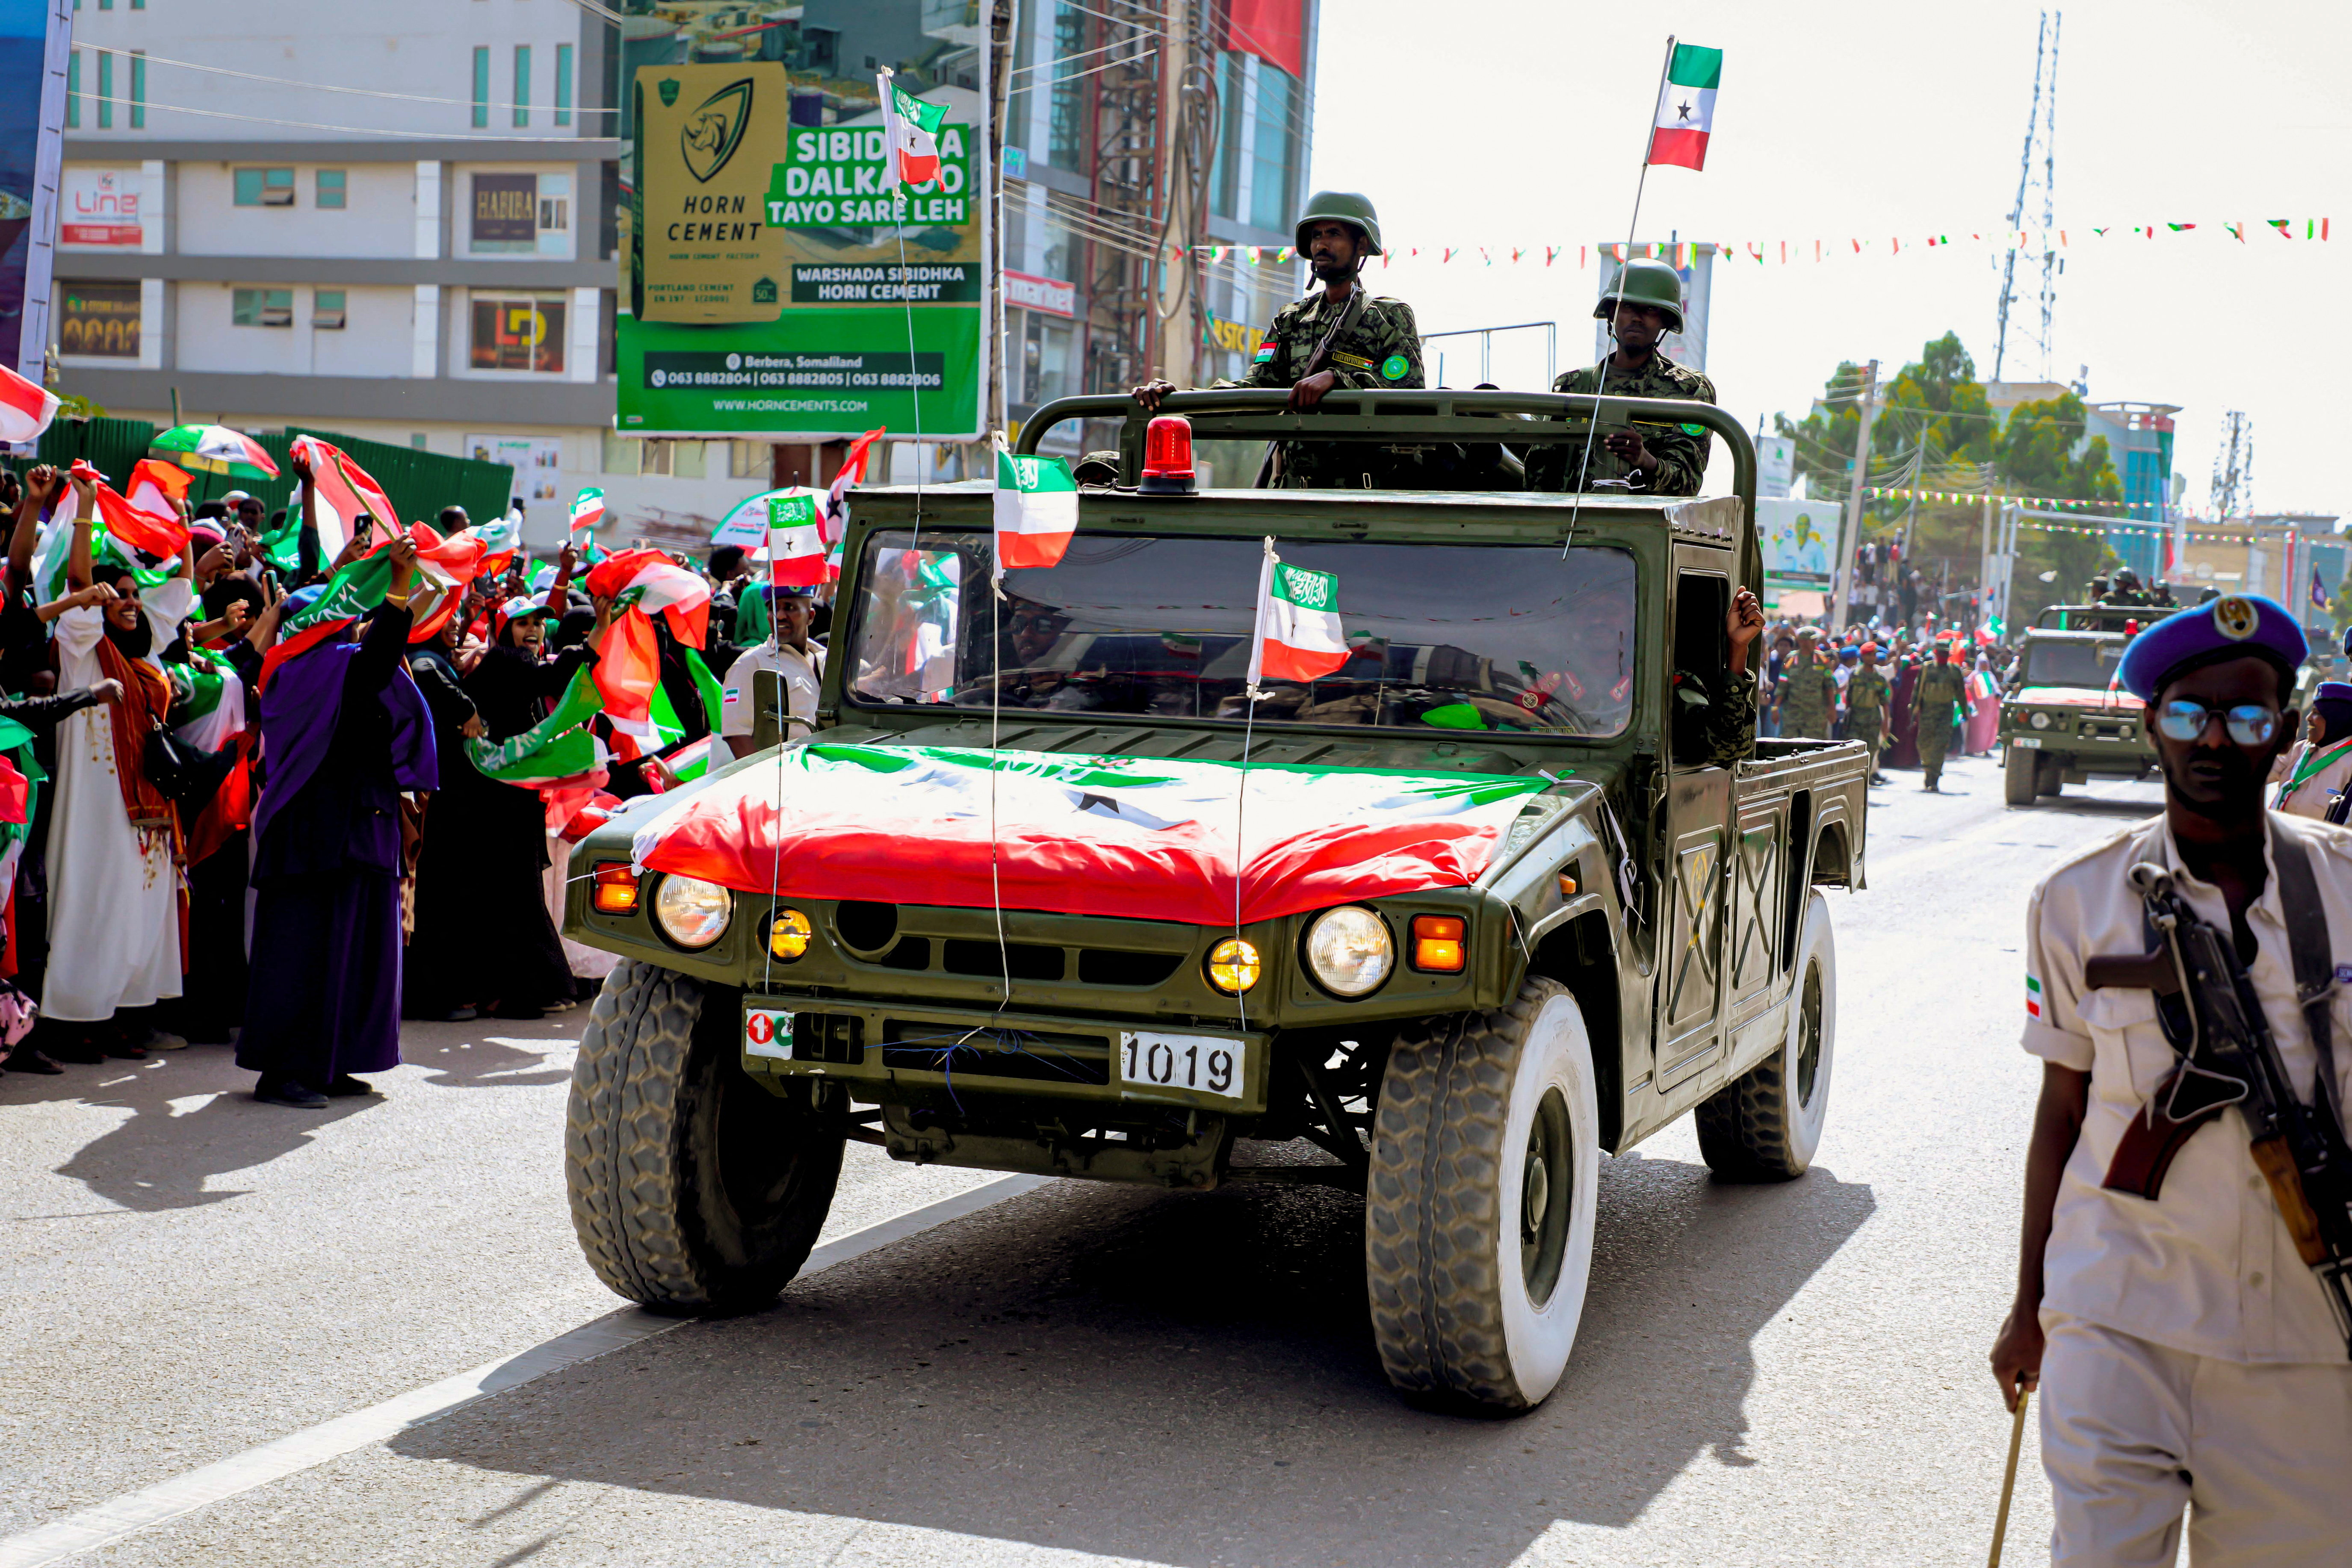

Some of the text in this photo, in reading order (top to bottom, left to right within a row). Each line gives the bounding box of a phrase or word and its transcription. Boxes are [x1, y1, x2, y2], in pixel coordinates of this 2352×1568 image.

[797, 129, 964, 162] SIBIDA
[683, 195, 745, 214] HORN
[768, 198, 963, 223] TAYO SARE LEH
[668, 223, 761, 241] CEMENT
[796, 267, 965, 282] WARSHADA SIBIDHKA
[818, 284, 942, 299] HORN CEMENT
[745, 356, 862, 369] Berbera, Somaliland
[668, 372, 692, 384] 063
[695, 372, 751, 385] 8882804
[760, 372, 785, 385] 063
[787, 372, 844, 385] 8882805
[853, 373, 878, 386] 063
[881, 373, 940, 386] 8882806
[713, 400, 868, 412] WWW.HORNCEMENTS.COM
[1127, 1038, 1232, 1091] 1019
